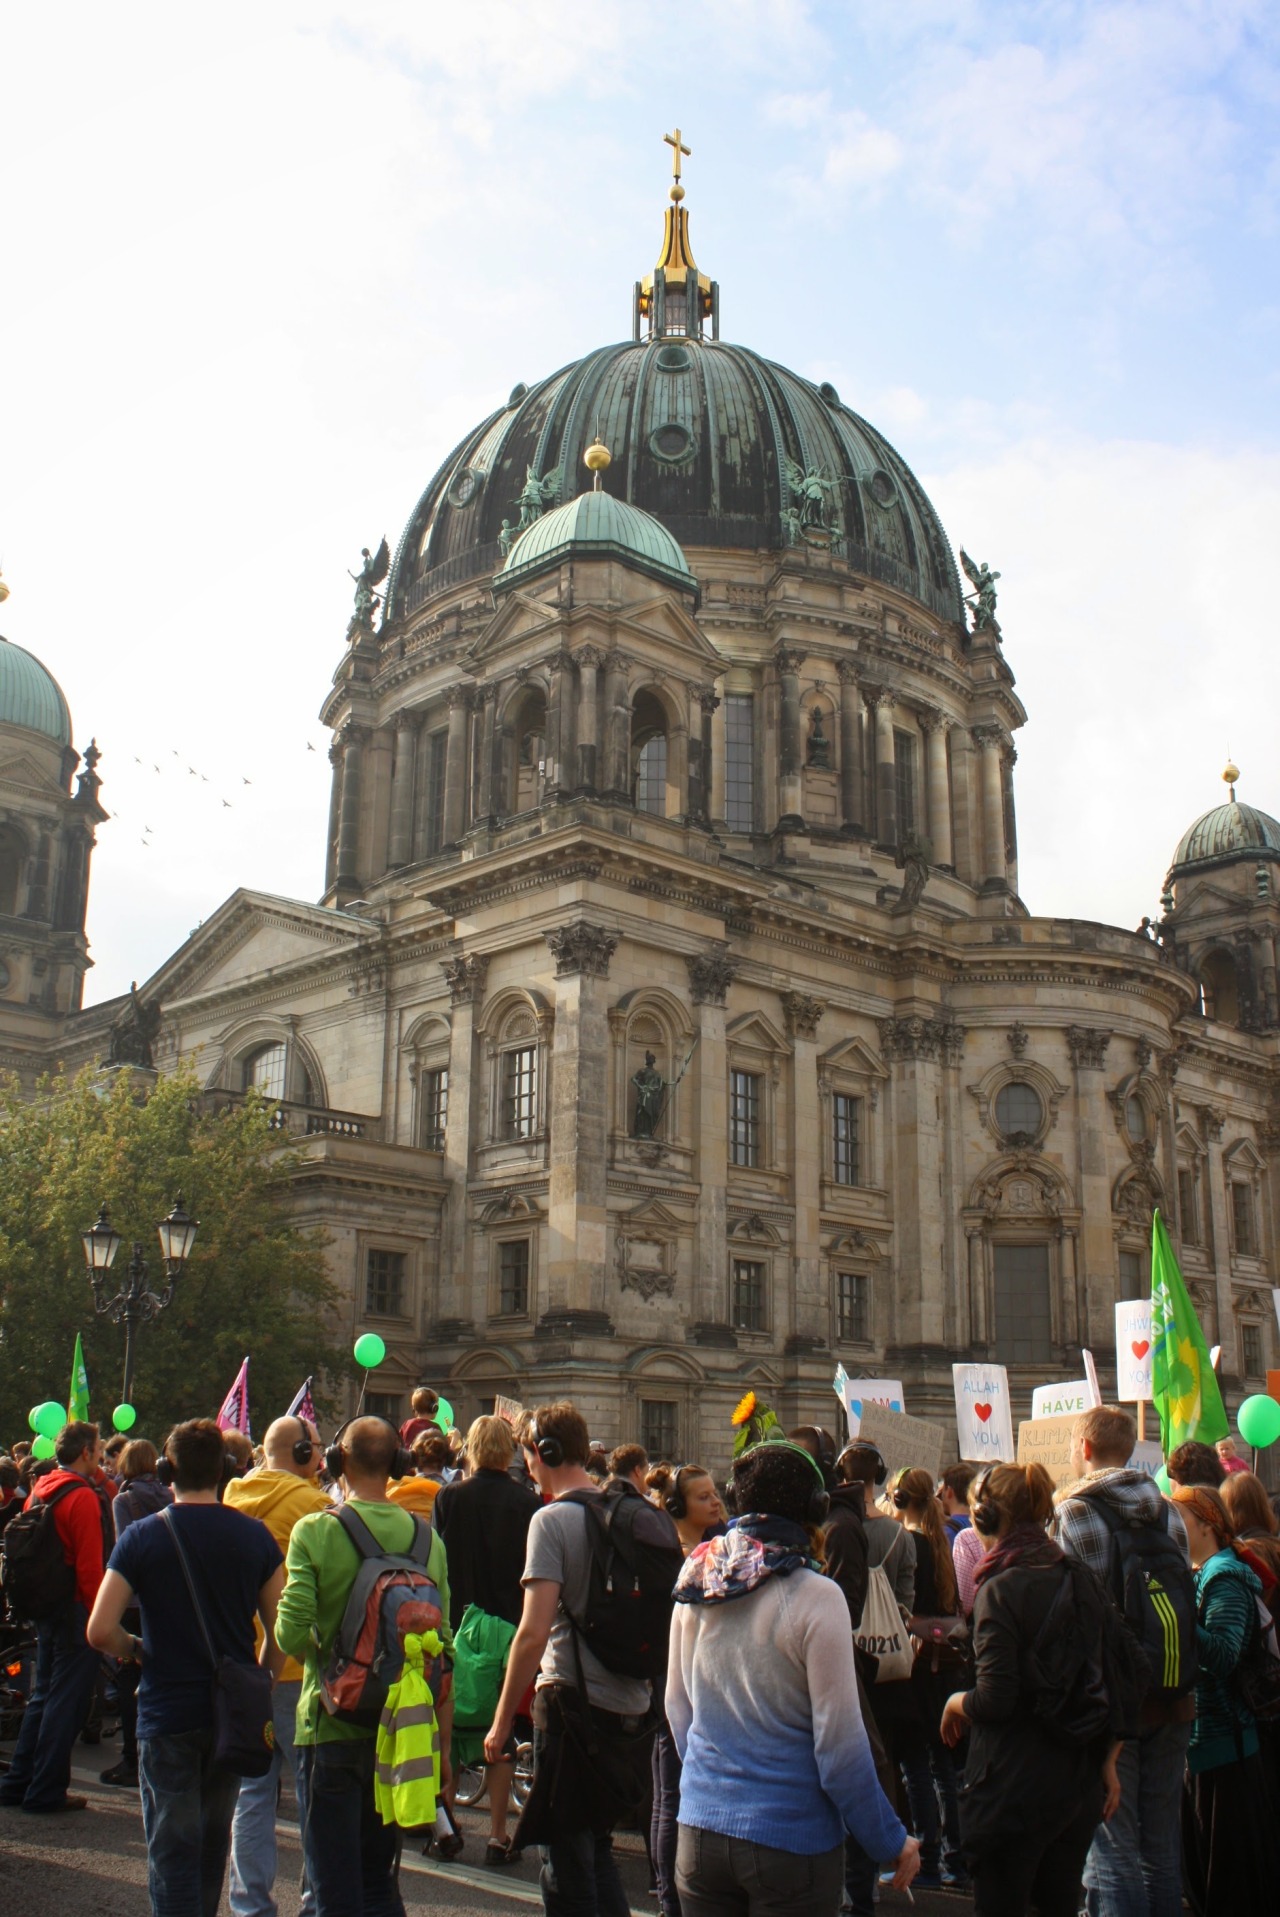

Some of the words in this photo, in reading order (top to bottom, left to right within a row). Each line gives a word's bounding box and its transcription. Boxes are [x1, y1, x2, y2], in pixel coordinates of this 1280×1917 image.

[963, 1380, 1000, 1394] ALLAH
[1042, 1397, 1084, 1414] HAVE
[972, 1431, 999, 1446] YOU
